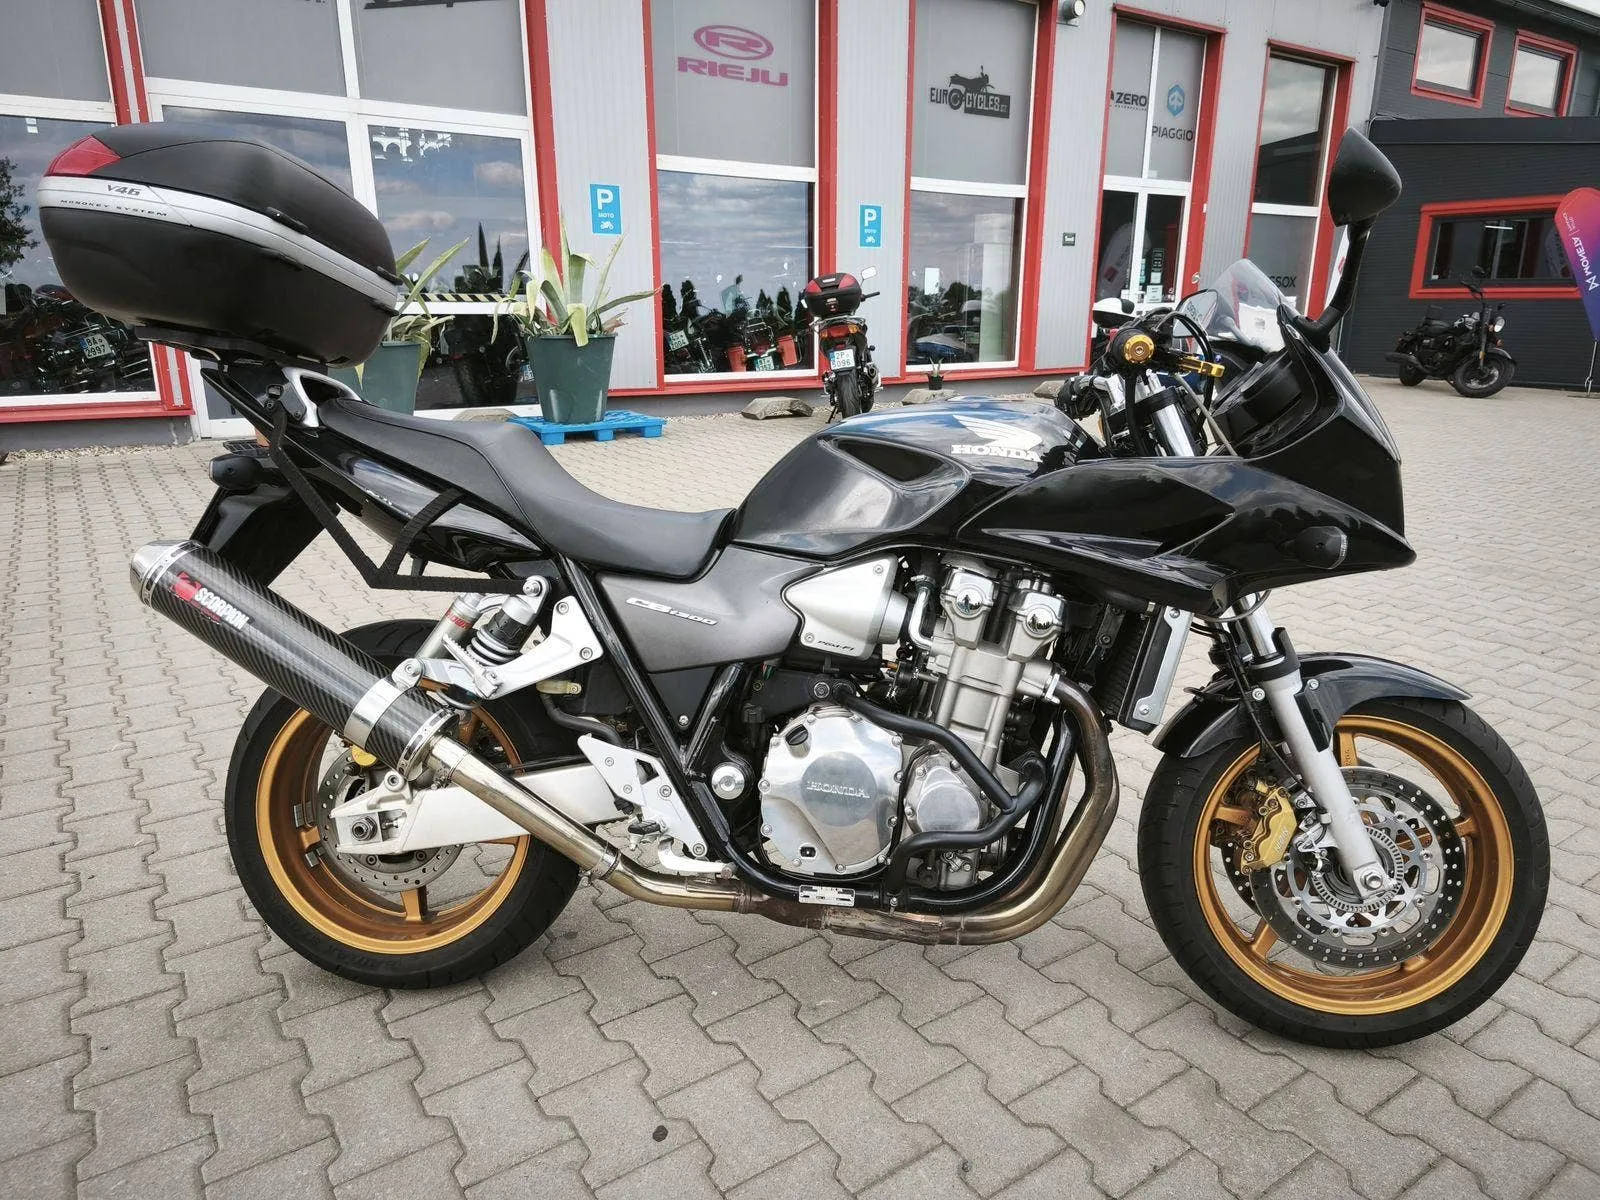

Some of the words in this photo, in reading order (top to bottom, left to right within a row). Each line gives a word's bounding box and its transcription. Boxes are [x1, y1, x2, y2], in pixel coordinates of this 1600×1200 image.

[677, 56, 789, 87] RIEJU
[1115, 91, 1148, 107] ZERO
[1151, 126, 1194, 141] PIAGGIO
[107, 184, 141, 197] V46
[596, 188, 614, 210] P
[60, 199, 109, 208] MONOKEY
[116, 205, 168, 217] SYSTEM
[864, 208, 877, 227] P
[951, 443, 1043, 463] HONDA
[195, 587, 250, 630] SCORPION
[805, 780, 871, 799] HONDA
